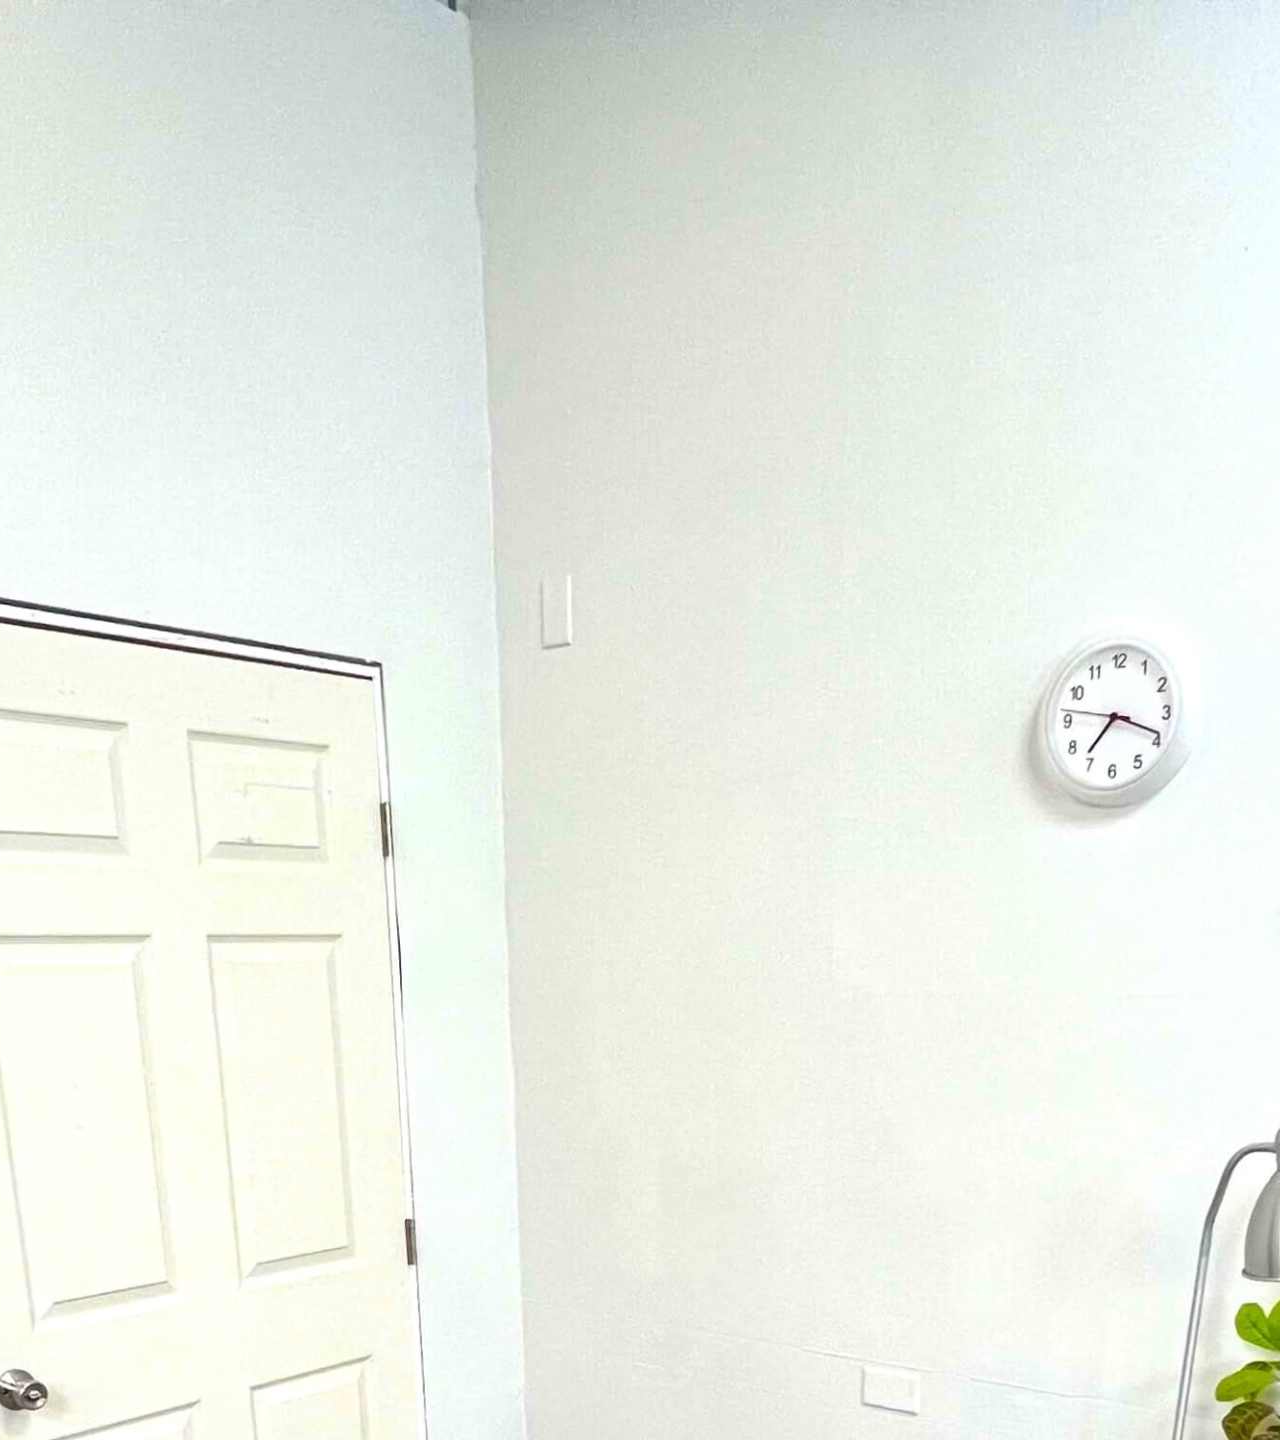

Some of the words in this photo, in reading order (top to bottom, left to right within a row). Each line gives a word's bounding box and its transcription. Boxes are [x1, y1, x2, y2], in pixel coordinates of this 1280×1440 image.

[1112, 653, 1128, 669] 12
[1141, 660, 1148, 675] 1
[1089, 665, 1101, 680] 11
[1157, 676, 1168, 693] 2
[1070, 685, 1084, 701] 10
[1162, 704, 1171, 720] 3
[1063, 713, 1072, 729] 9
[1152, 731, 1161, 748] 4
[1068, 740, 1077, 755] 8
[1086, 757, 1095, 772] 7
[1133, 754, 1143, 769] 5
[1108, 764, 1117, 779] 6
